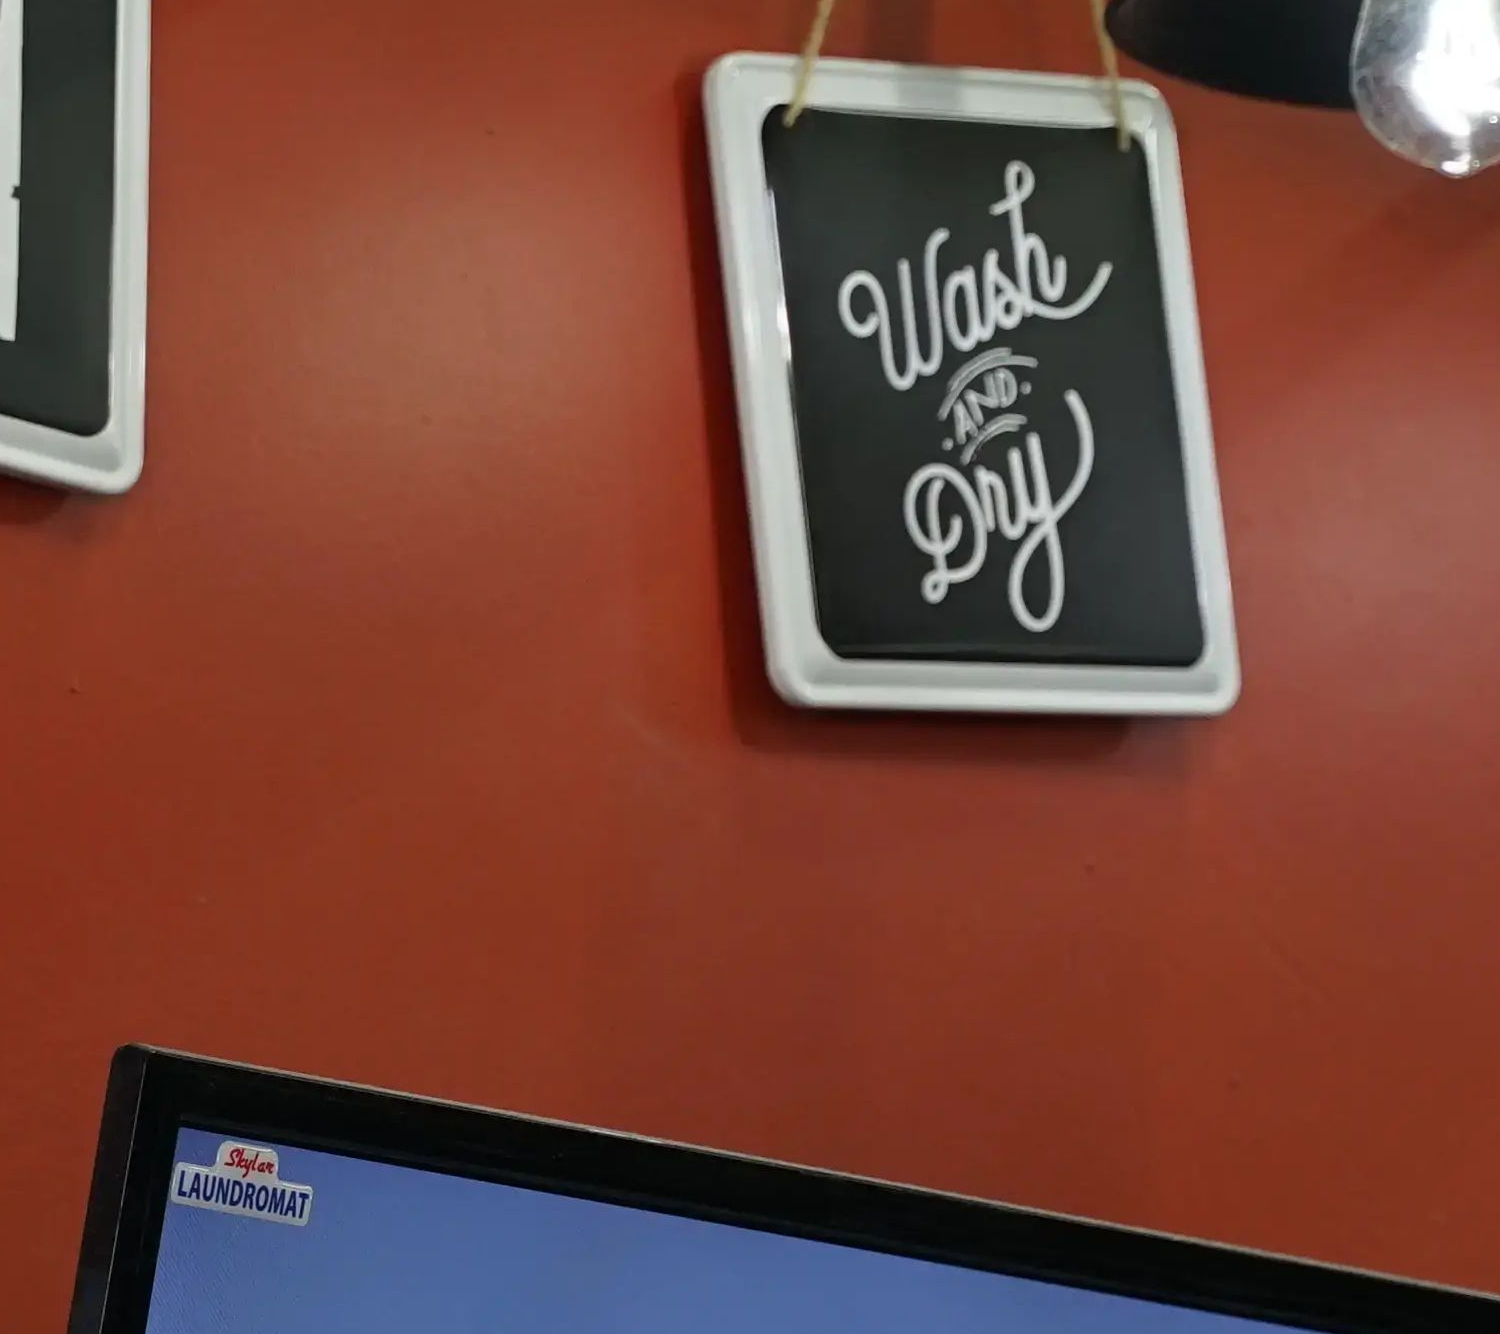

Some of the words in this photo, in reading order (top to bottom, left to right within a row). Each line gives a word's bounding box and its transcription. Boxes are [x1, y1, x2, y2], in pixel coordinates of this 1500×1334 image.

[837, 158, 1114, 393] Wash
[952, 366, 1019, 446] AND
[902, 388, 1095, 634] Dry
[176, 1168, 311, 1220] LAUNDROMAT
[223, 1147, 276, 1179] Skylar
